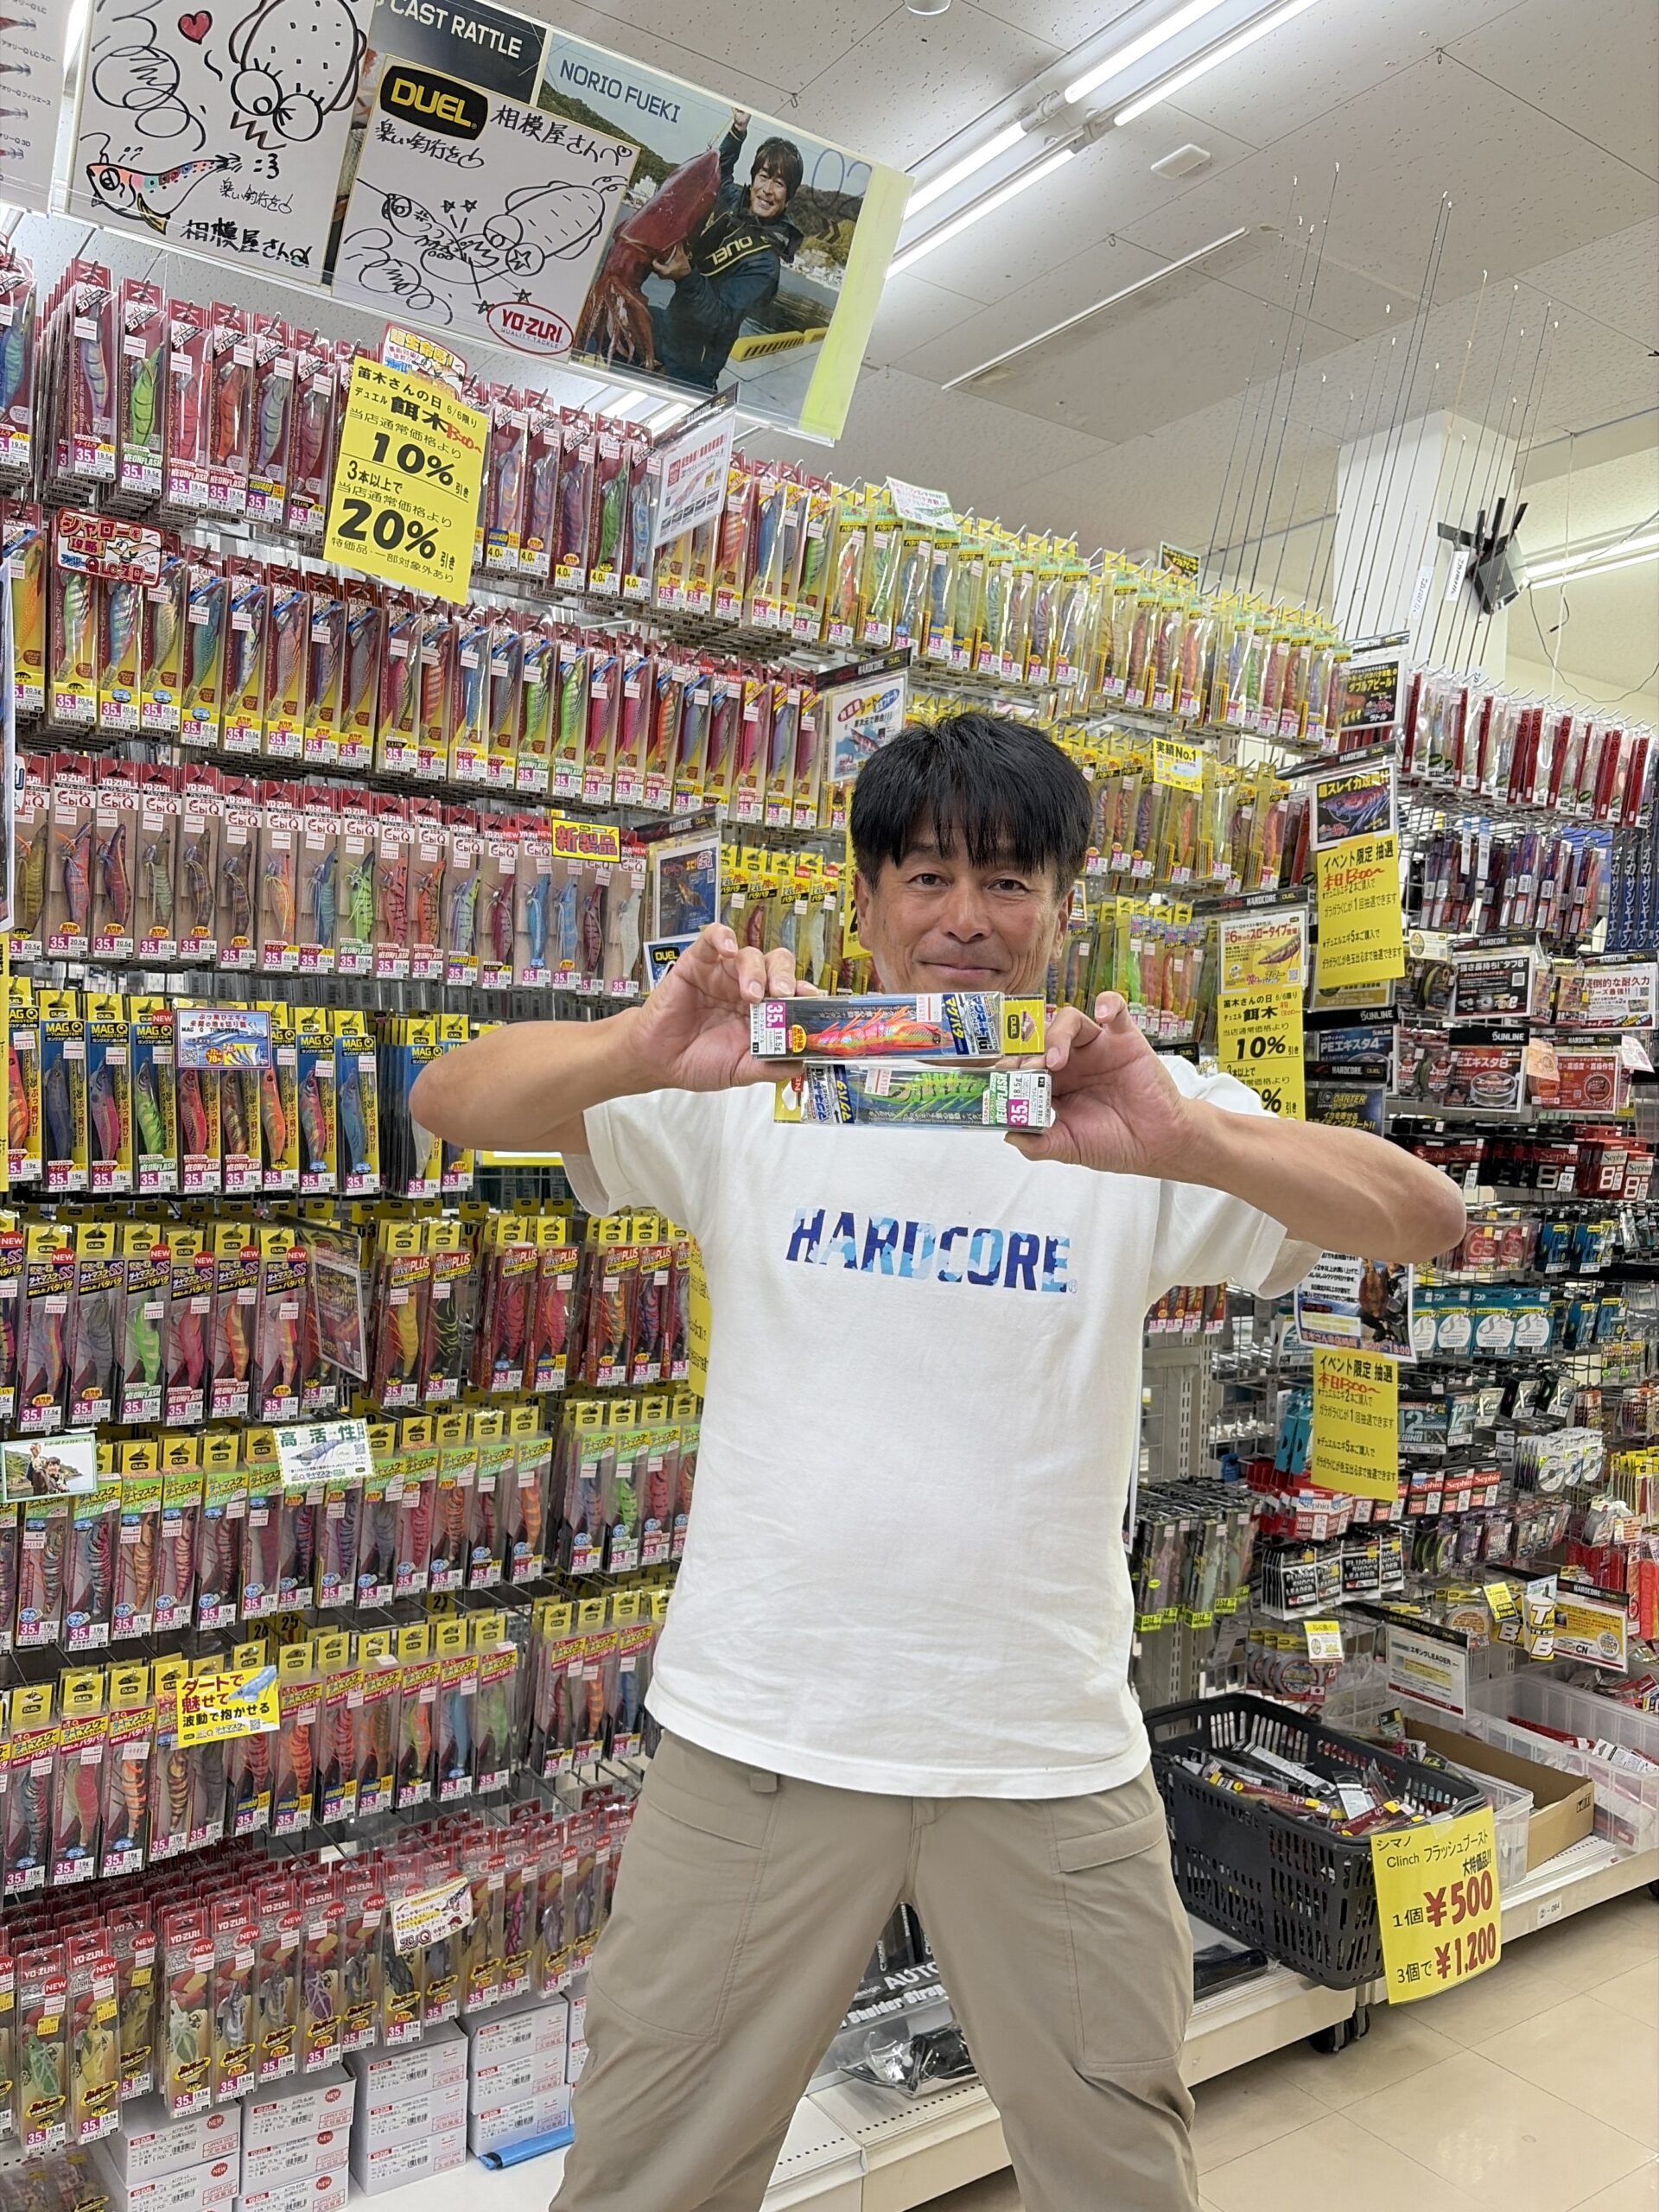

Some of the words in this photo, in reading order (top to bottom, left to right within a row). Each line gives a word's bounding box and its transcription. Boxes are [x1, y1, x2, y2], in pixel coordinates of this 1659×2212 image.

[451, 16, 524, 59] RATTLE
[560, 59, 622, 99] NORIO
[625, 86, 681, 124] FUEKI
[390, 77, 474, 129] DUEL
[22, 138, 31, 147] 3D
[501, 308, 563, 342] YO-ZURI
[357, 365, 442, 410] 笛木さんの日
[446, 405, 478, 429] 6/6限り
[353, 385, 388, 406] デュエル
[391, 395, 448, 433] 餌木
[349, 406, 462, 460] 当店通常価格より
[123, 452, 162, 467] NEONFLASH
[372, 432, 454, 486] 10%
[455, 481, 470, 498] 引き
[170, 468, 208, 482] NEONFLASH
[346, 460, 404, 496] 3本以上で
[336, 480, 453, 528] 当店通常価格より
[337, 497, 438, 560] 20%
[440, 550, 456, 571] 引き
[888, 655, 900, 664] DUEL
[1339, 749, 1368, 763] HARDCORE
[56, 772, 87, 783] YO-ZURI
[143, 783, 170, 793] YO-ZURI
[186, 783, 213, 793] YO-ZURI
[556, 824, 620, 856] 新製品
[632, 846, 647, 855] NEW
[1324, 846, 1373, 873] イベント限定
[1376, 840, 1394, 861] 抽選
[1247, 894, 1277, 906] HARDCORE
[1281, 892, 1296, 900] DUEL
[1479, 937, 1507, 946] HARDCORE
[654, 950, 678, 963] DUEL
[1599, 953, 1629, 963] HARDCORE
[1224, 994, 1272, 1008] 笛木さんの日
[153, 1014, 173, 1023] NEW
[968, 1000, 980, 1039] MAGNET
[1360, 1010, 1394, 1021] SUNLINE
[46, 1022, 68, 1034] MAG
[92, 1024, 113, 1034] MAG
[137, 1026, 158, 1036] MAG
[1009, 1017, 1018, 1037] DUEL
[1224, 1023, 1289, 1037] 当店通常価格より
[1492, 1032, 1525, 1041] SUNLINE
[1236, 1035, 1286, 1060] 10%
[1287, 1046, 1299, 1056] 引き
[1332, 1066, 1363, 1075] HARDCORE
[793, 1077, 802, 1091] NE
[1013, 1077, 1021, 1097] 18.5g
[1333, 1093, 1367, 1105] DARTER
[1541, 1150, 1579, 1162] Sephia
[1536, 1165, 1559, 1189] 8
[53, 1253, 74, 1262] NEW
[519, 1249, 537, 1264] PLUS
[621, 1247, 639, 1263] PLUS
[785, 1208, 1071, 1294] HARDCORE
[1320, 1355, 1371, 1379] イベント限定
[1375, 1363, 1393, 1382] 抽選
[279, 1424, 356, 1447] 高活性
[1446, 1478, 1472, 1490] Sephia
[1475, 1474, 1500, 1484] Sephia
[1345, 1558, 1377, 1567] FLUORO
[1352, 1565, 1379, 1573] SHOCK
[1344, 1571, 1375, 1581] LEADER
[1573, 1585, 1602, 1598] HARDCORE
[181, 1674, 244, 1697] ダートで
[181, 1692, 230, 1714] 魅せて
[182, 1702, 270, 1727] 波動で抱かせる
[1376, 1835, 1412, 1851] シマノ
[1387, 1854, 1420, 1868] Clinch
[1424, 1829, 1489, 1863] フラッシュブースト
[1462, 1848, 1492, 1877] 大特価品!!
[1392, 1907, 1424, 1928] 1個
[1423, 1870, 1493, 1928] ¥500
[283, 1915, 304, 1926] NEW
[1397, 1959, 1432, 1984] 3個で
[1434, 1922, 1497, 1980] ¥1,200
